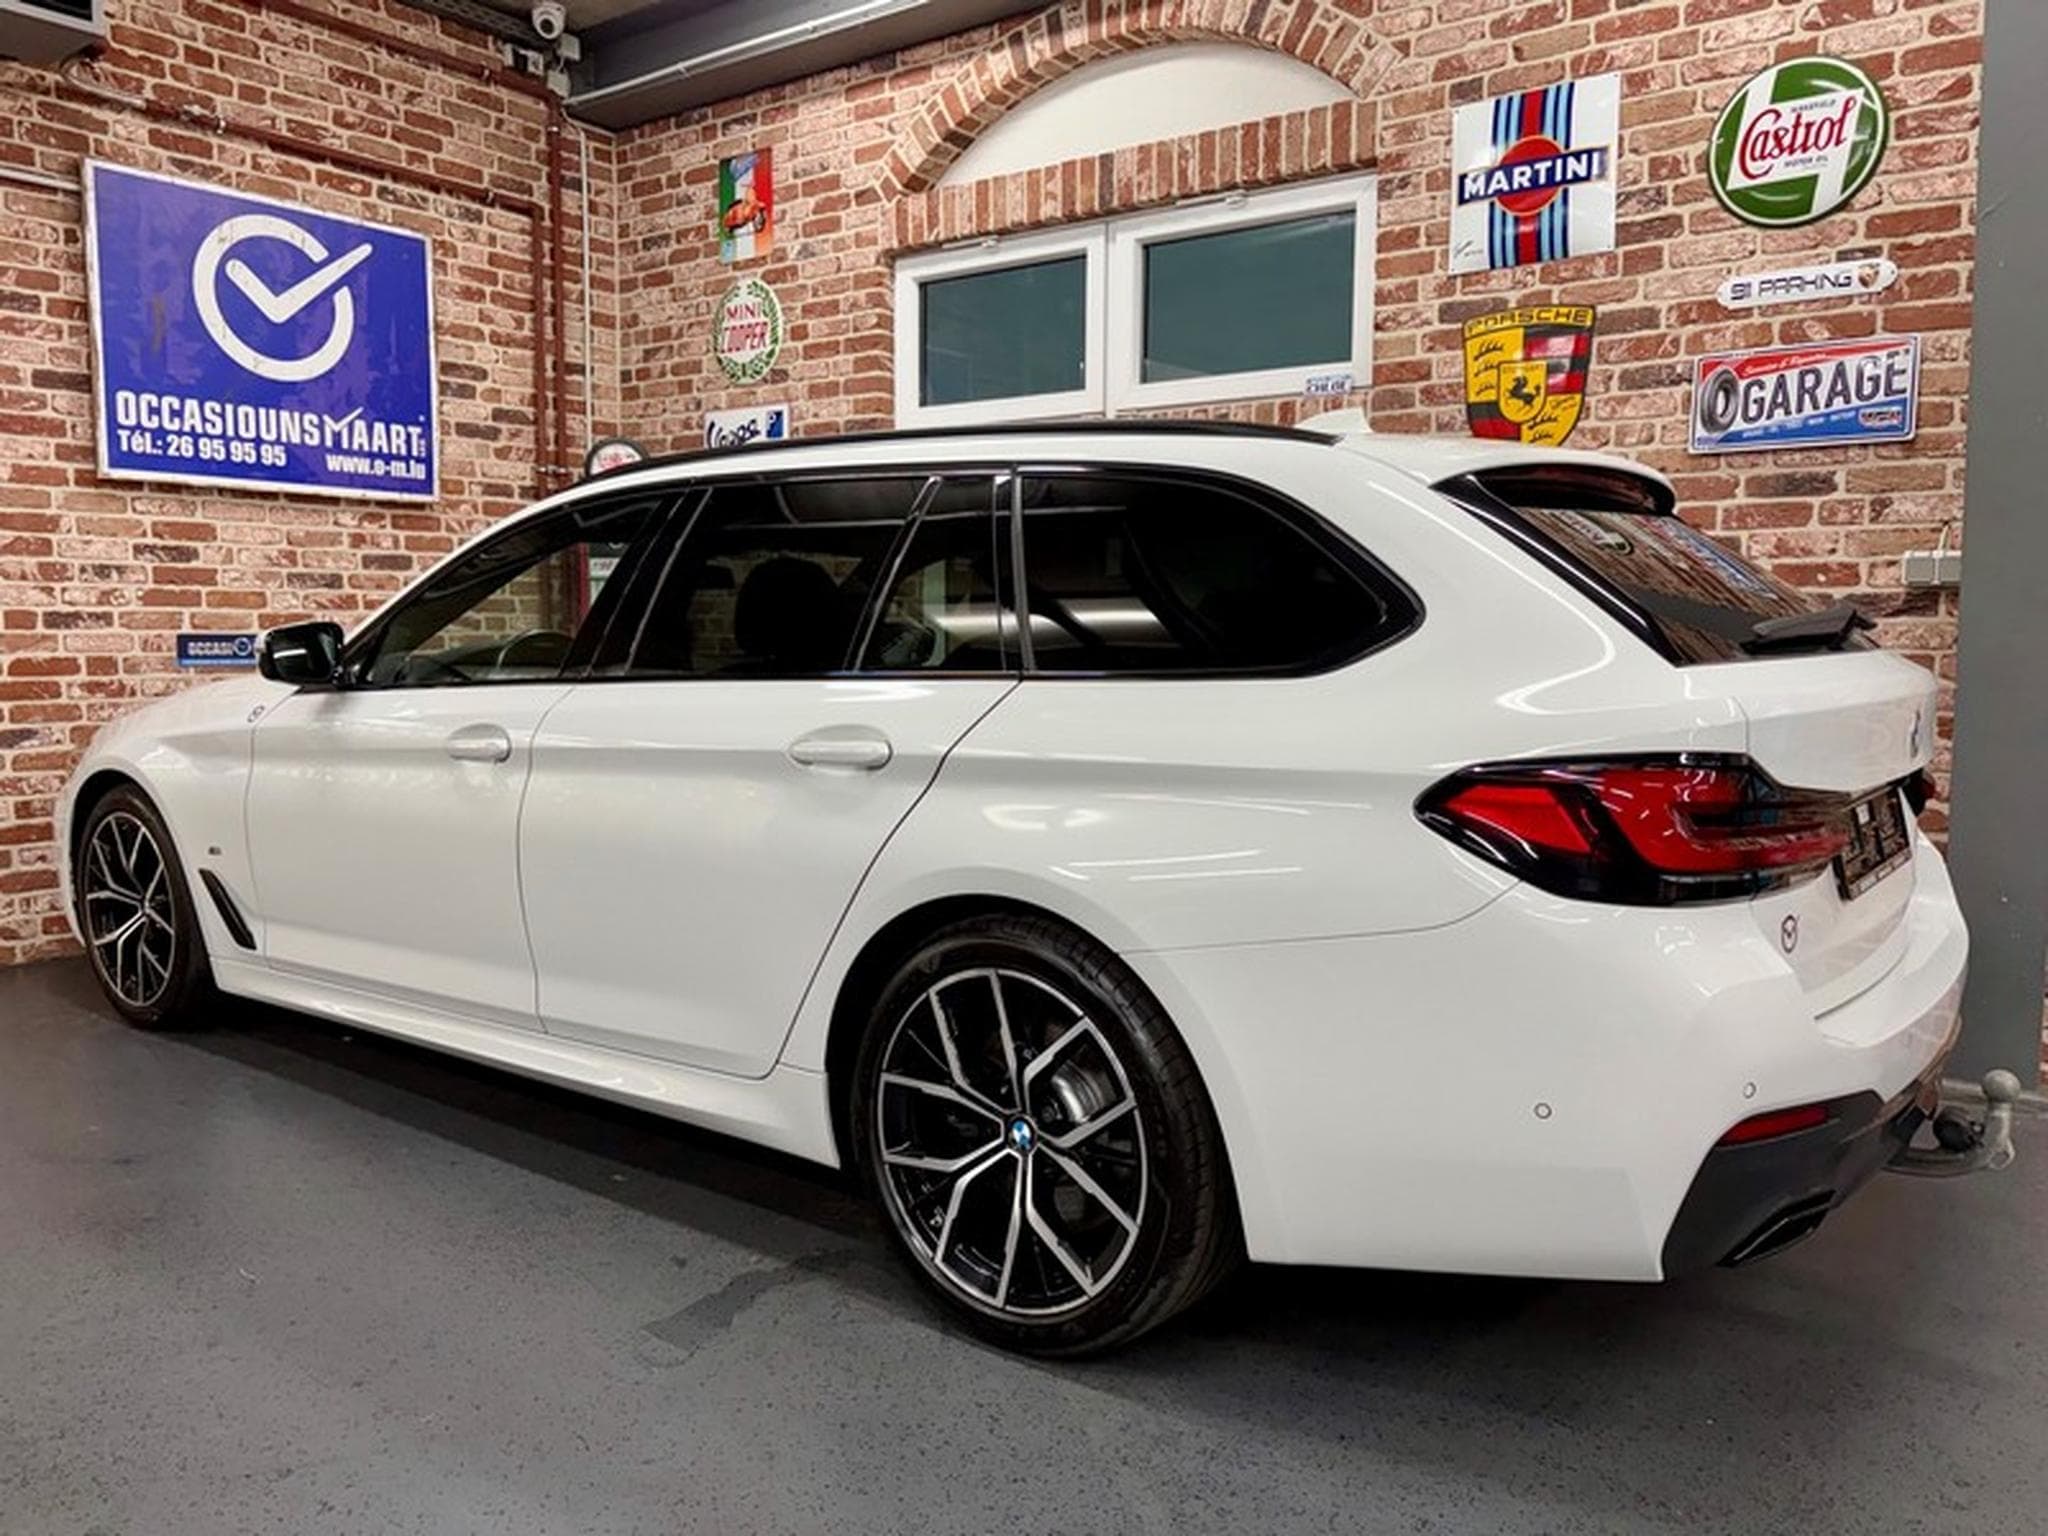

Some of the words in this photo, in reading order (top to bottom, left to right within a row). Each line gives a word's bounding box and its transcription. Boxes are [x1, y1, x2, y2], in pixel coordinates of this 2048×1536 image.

[1739, 96, 1857, 180] Castrol
[1463, 151, 1600, 200] MARTINI
[1758, 271, 1853, 298] PARKING
[725, 302, 763, 322] MINI
[1466, 308, 1590, 335] PORSCHE
[1740, 347, 1911, 425] GARAGE
[115, 389, 422, 457] OCCASIOUNSMAART
[166, 433, 195, 459] 26
[198, 437, 226, 462] 95
[230, 440, 257, 465] 95
[260, 443, 287, 467] 95
